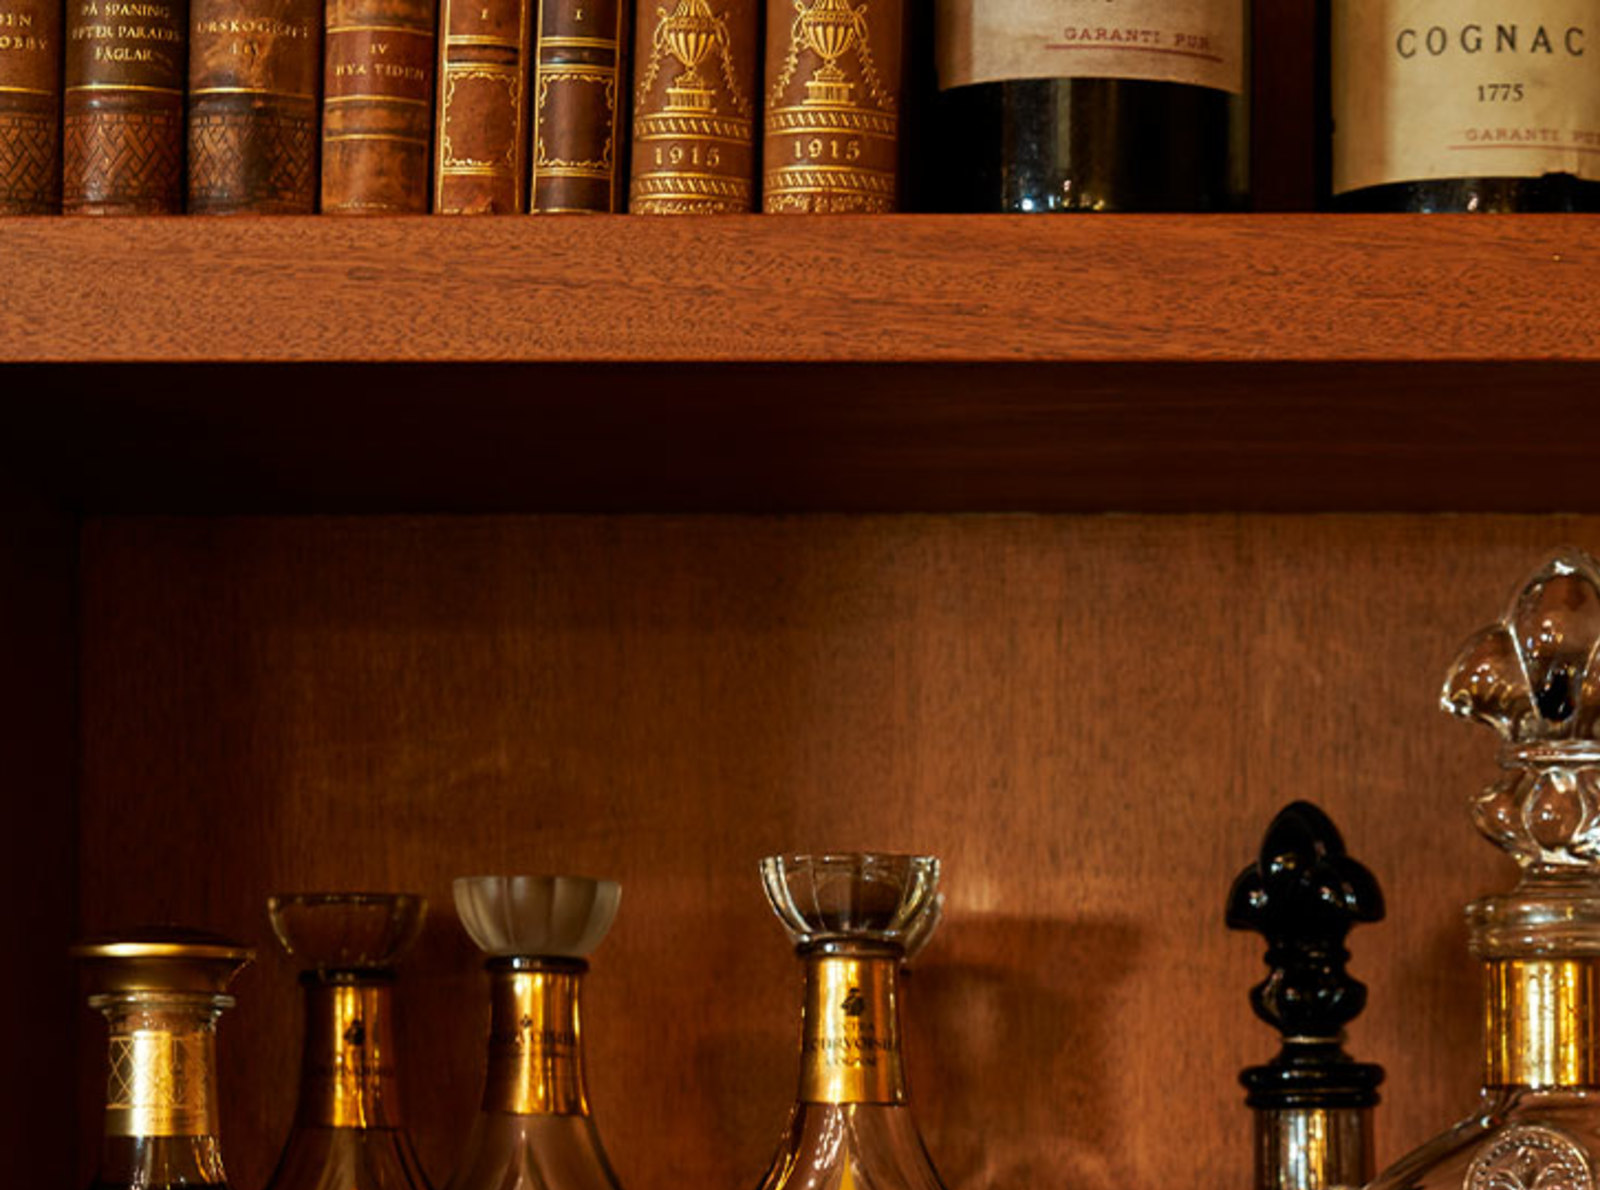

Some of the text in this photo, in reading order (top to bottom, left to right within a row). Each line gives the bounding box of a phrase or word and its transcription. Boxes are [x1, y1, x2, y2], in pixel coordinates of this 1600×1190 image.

[105, 2, 170, 18] SPANING
[1064, 27, 1209, 49] GARANTI PUR
[1396, 24, 1585, 58] COGNAC
[95, 46, 153, 61] FÅGLAR
[370, 43, 388, 55] IV
[374, 63, 425, 80] TIDEN
[1478, 84, 1524, 102] 1775
[1465, 127, 1560, 142] GARANTI
[656, 143, 720, 167] 1915
[794, 138, 860, 160] 1915
